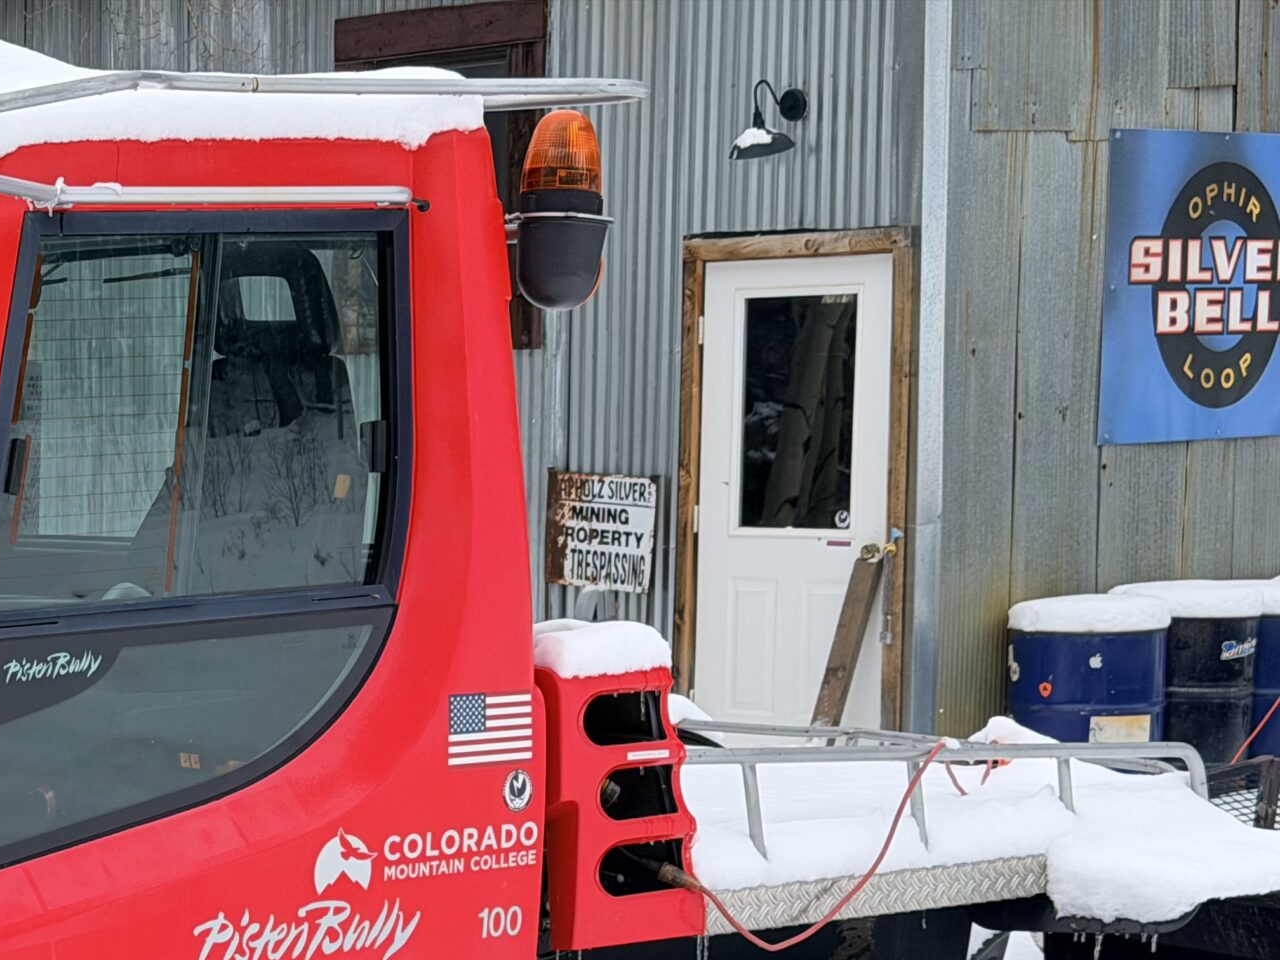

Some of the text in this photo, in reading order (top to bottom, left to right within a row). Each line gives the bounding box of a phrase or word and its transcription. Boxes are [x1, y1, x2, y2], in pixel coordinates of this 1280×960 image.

[1188, 181, 1261, 223] OPHIR
[1129, 237, 1280, 283] SILVE
[1156, 289, 1280, 334] BELL
[1183, 352, 1251, 389] LOOP
[608, 480, 646, 503] SILVER
[571, 505, 630, 525] MINING
[565, 526, 645, 549] ROPERTY
[570, 548, 646, 588] TRESPASSING
[3, 650, 102, 684] PistenBully
[384, 821, 538, 861] COLORADO
[384, 850, 537, 881] MOUNTAIN COLLEGE
[478, 905, 523, 938] 100
